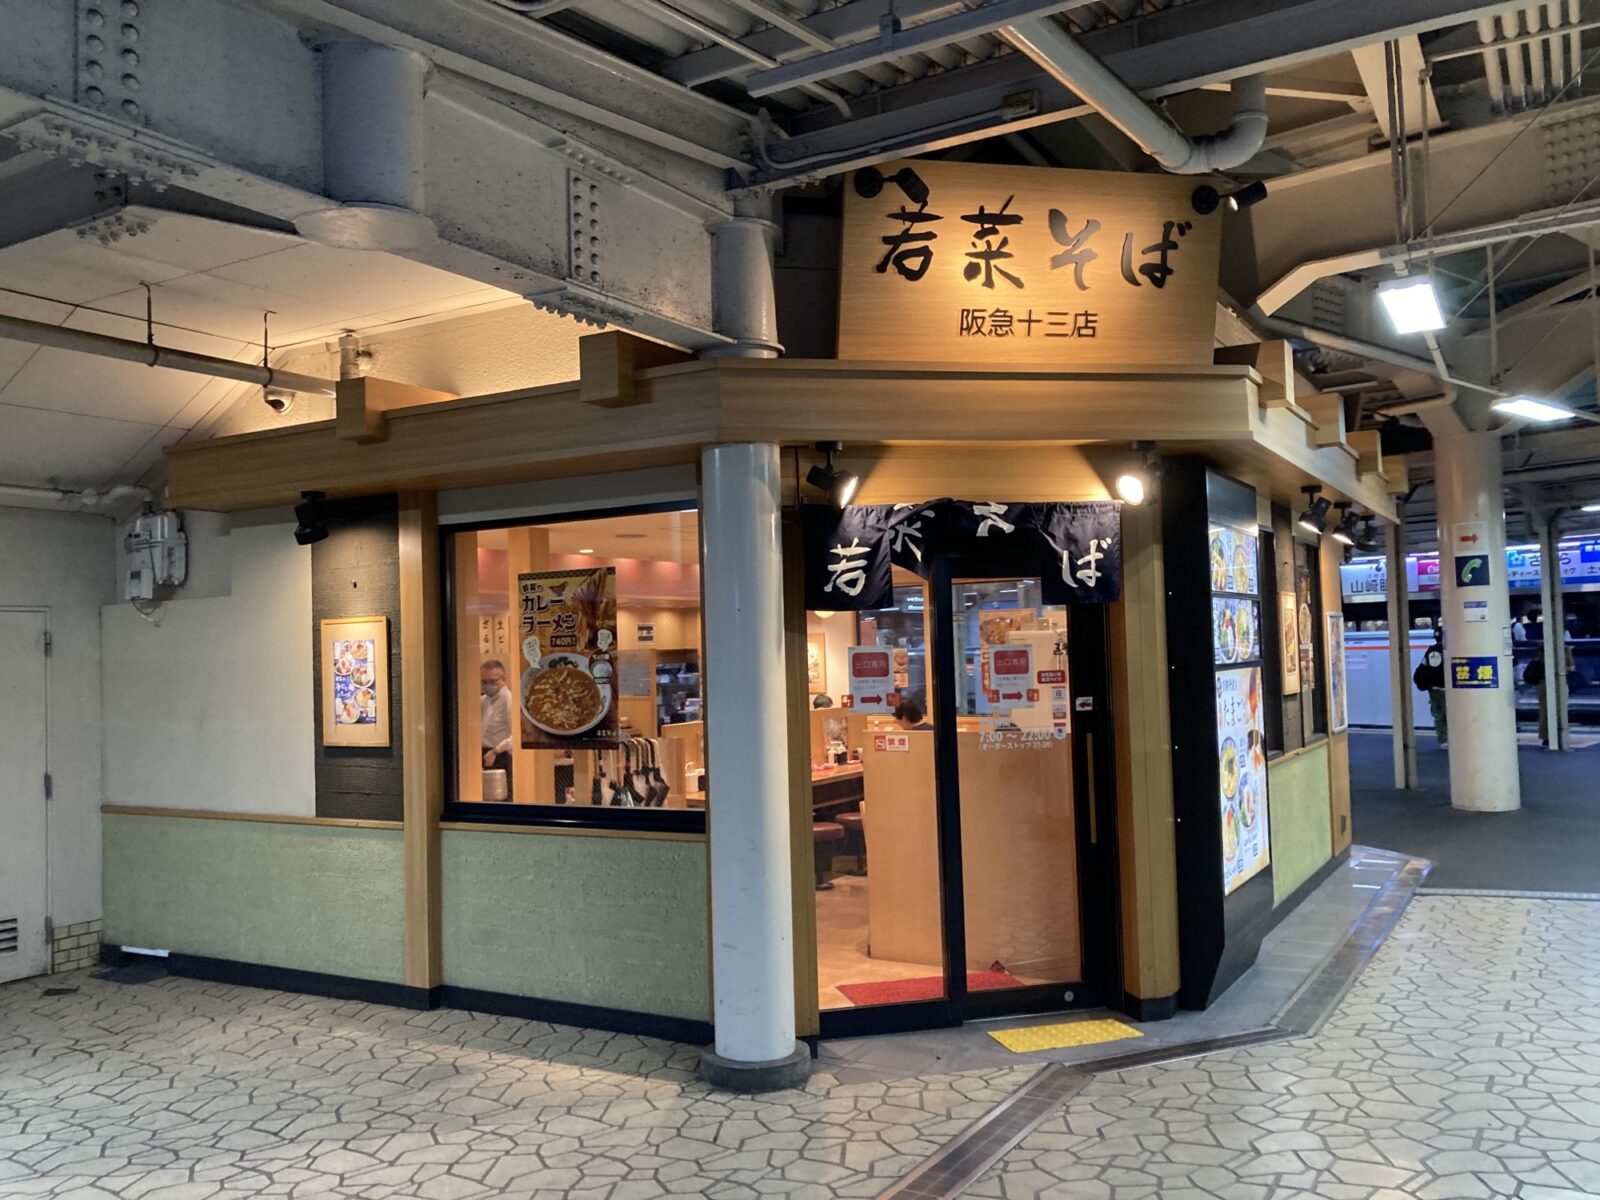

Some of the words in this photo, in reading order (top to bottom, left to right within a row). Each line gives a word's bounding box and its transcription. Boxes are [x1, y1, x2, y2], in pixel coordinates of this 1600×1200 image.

[875, 194, 1192, 291] 若菜そば
[958, 307, 1099, 338] 阪急十三店
[522, 594, 563, 612] カレー
[979, 731, 1003, 742] 7:00
